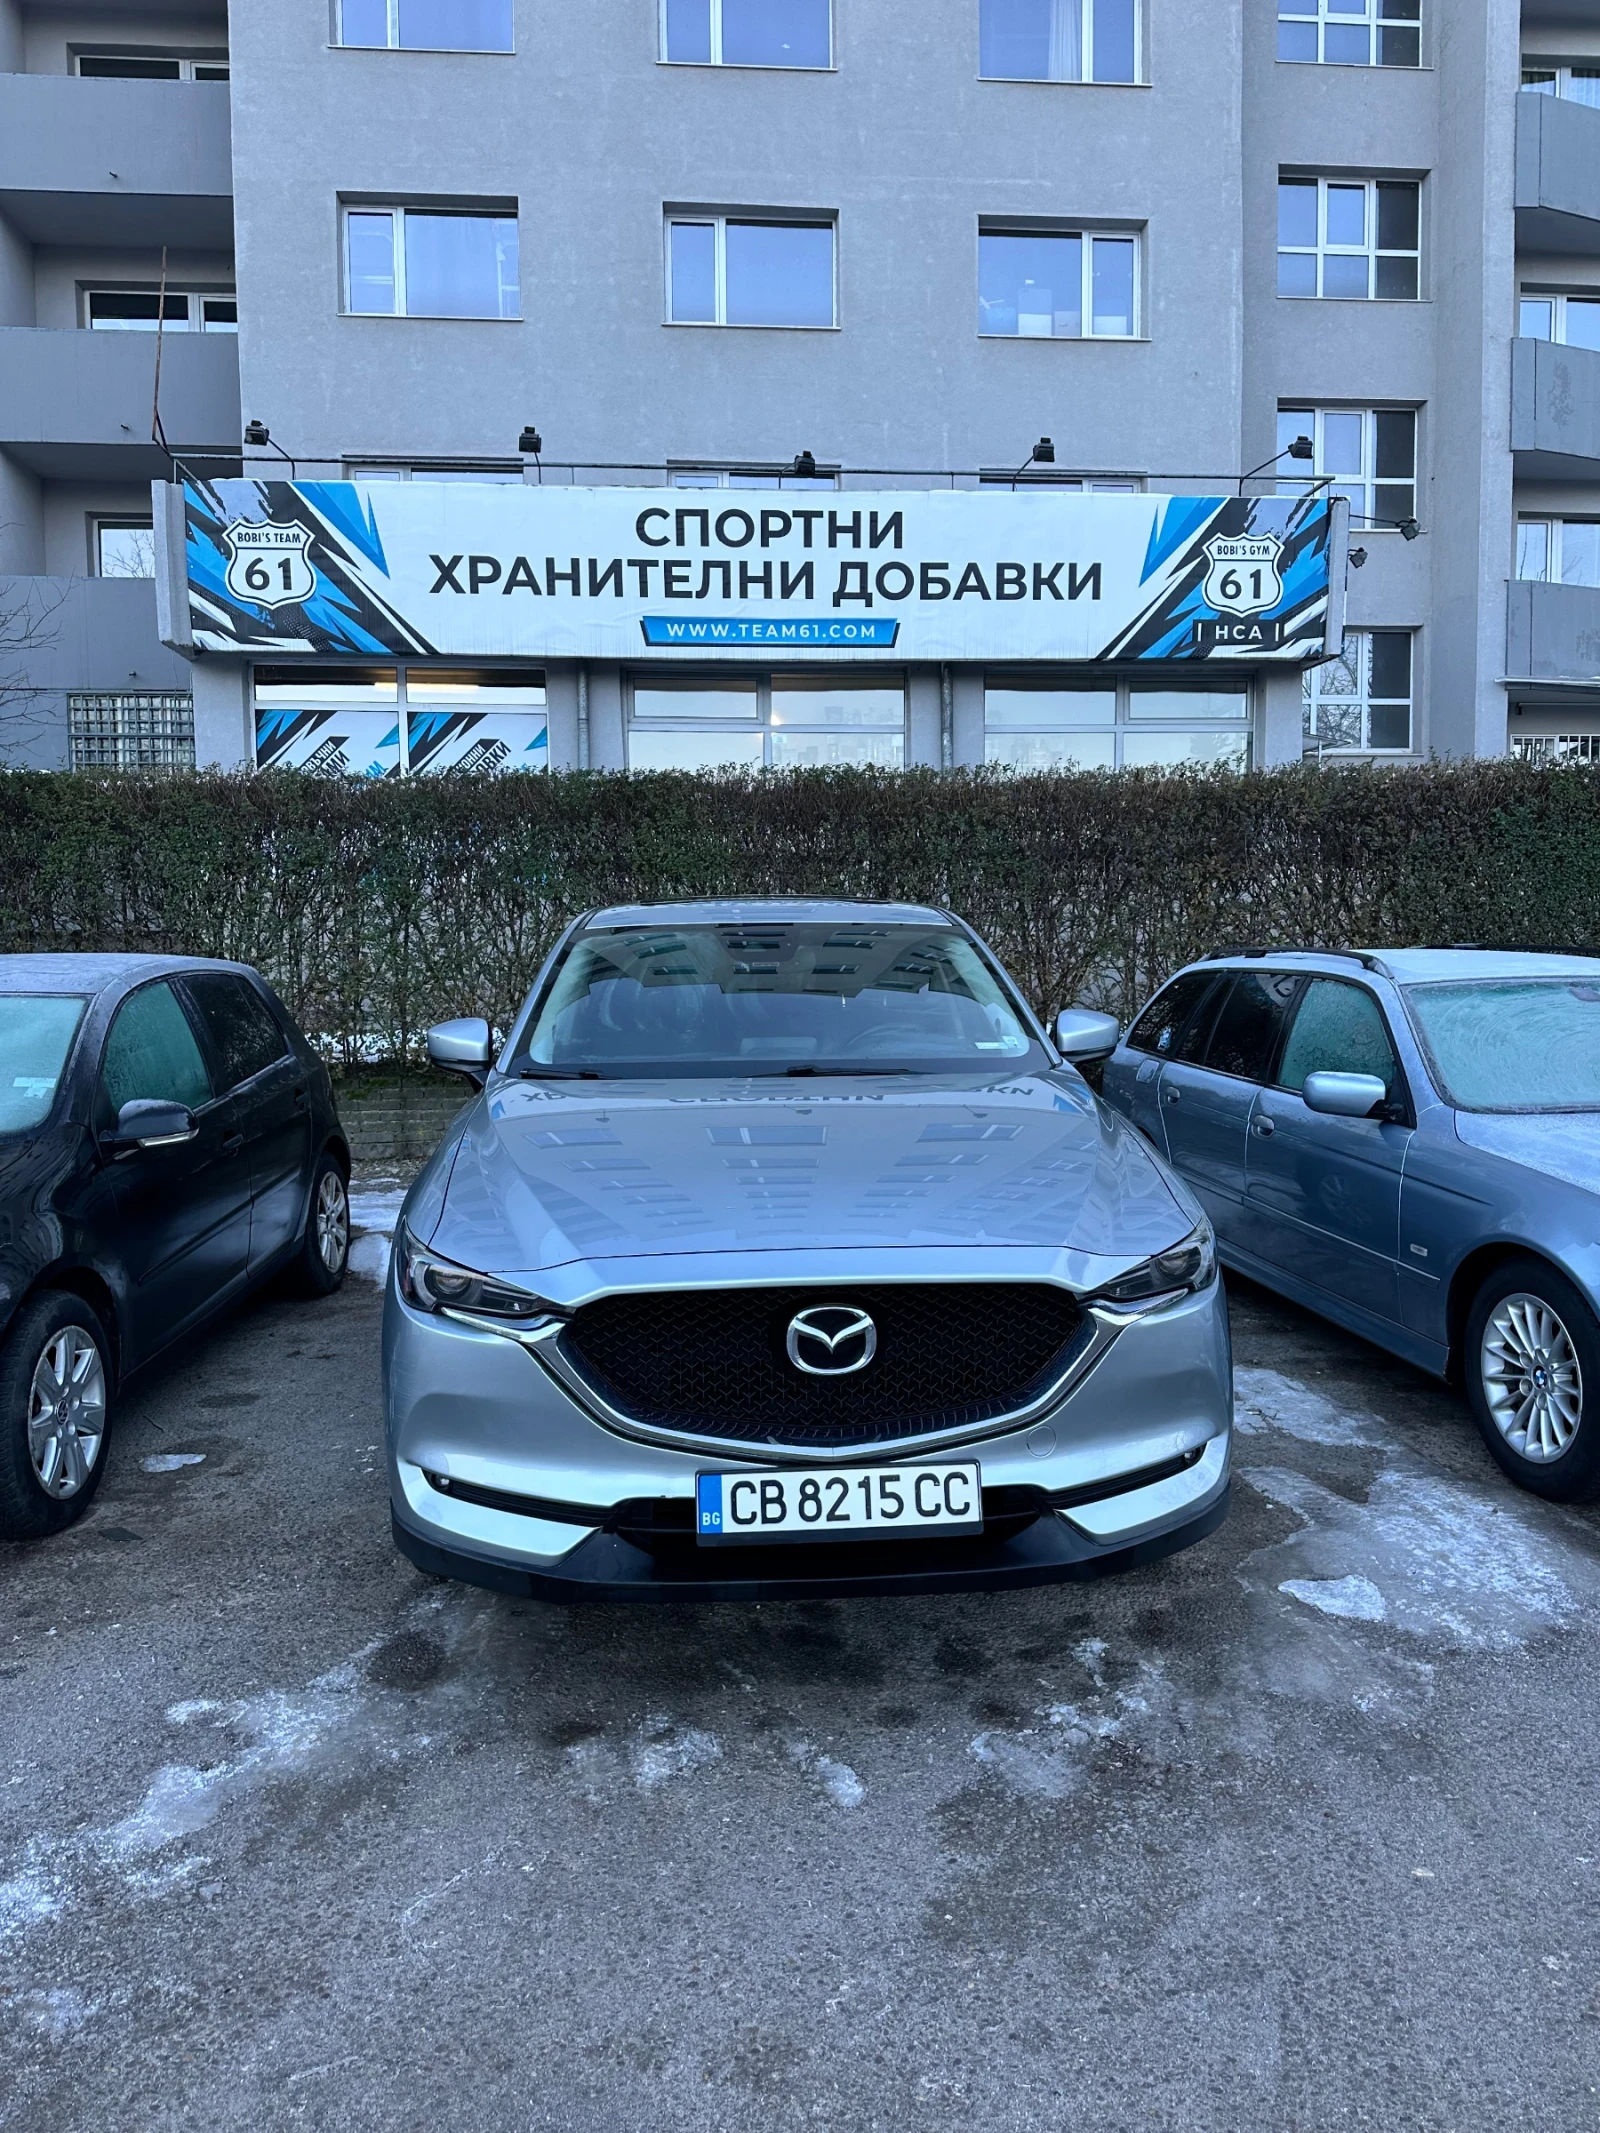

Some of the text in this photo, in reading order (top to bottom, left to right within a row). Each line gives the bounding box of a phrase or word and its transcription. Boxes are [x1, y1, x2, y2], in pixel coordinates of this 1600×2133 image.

[237, 532, 301, 544] BOBI'S TEAM
[635, 507, 903, 549] СПОРТНИ
[1217, 545, 1270, 556] BOBI'S GYM
[244, 557, 292, 591] 61
[428, 554, 1102, 608] ХРАНИТЕЛНИ ДОБАВКИ
[1219, 568, 1262, 600] 61
[666, 623, 876, 638] WWW.TEAM61.COM
[702, 1471, 971, 1526] BG CB 8215 CC
